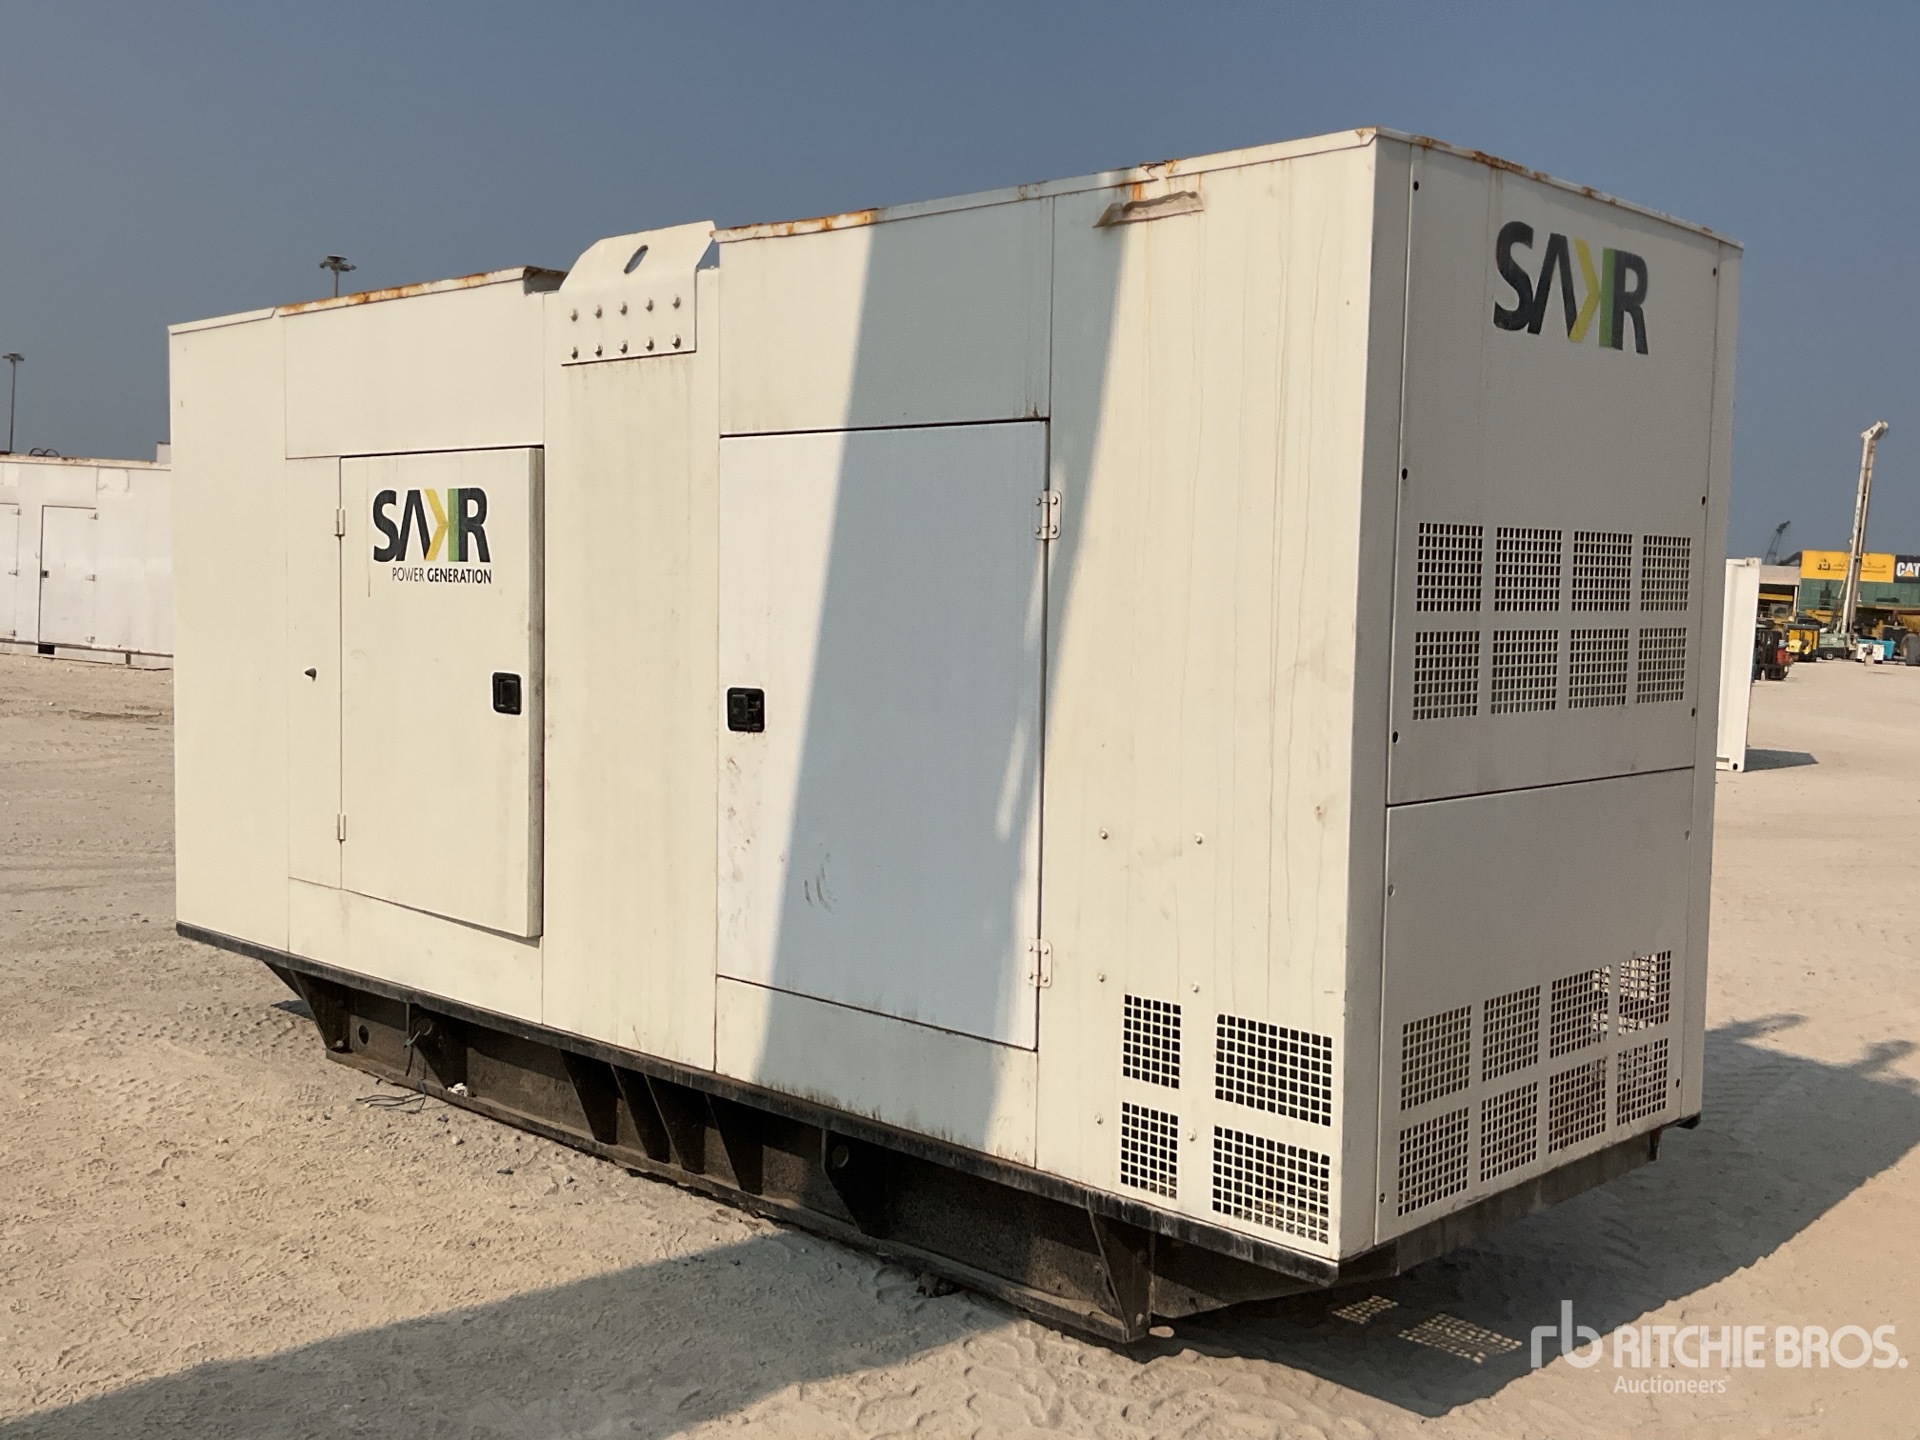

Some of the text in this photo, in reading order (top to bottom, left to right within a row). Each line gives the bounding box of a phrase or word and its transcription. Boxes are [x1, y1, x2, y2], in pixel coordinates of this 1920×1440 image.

[392, 567, 492, 584] POWER GENERATION
[1896, 561, 1920, 577] CAT
